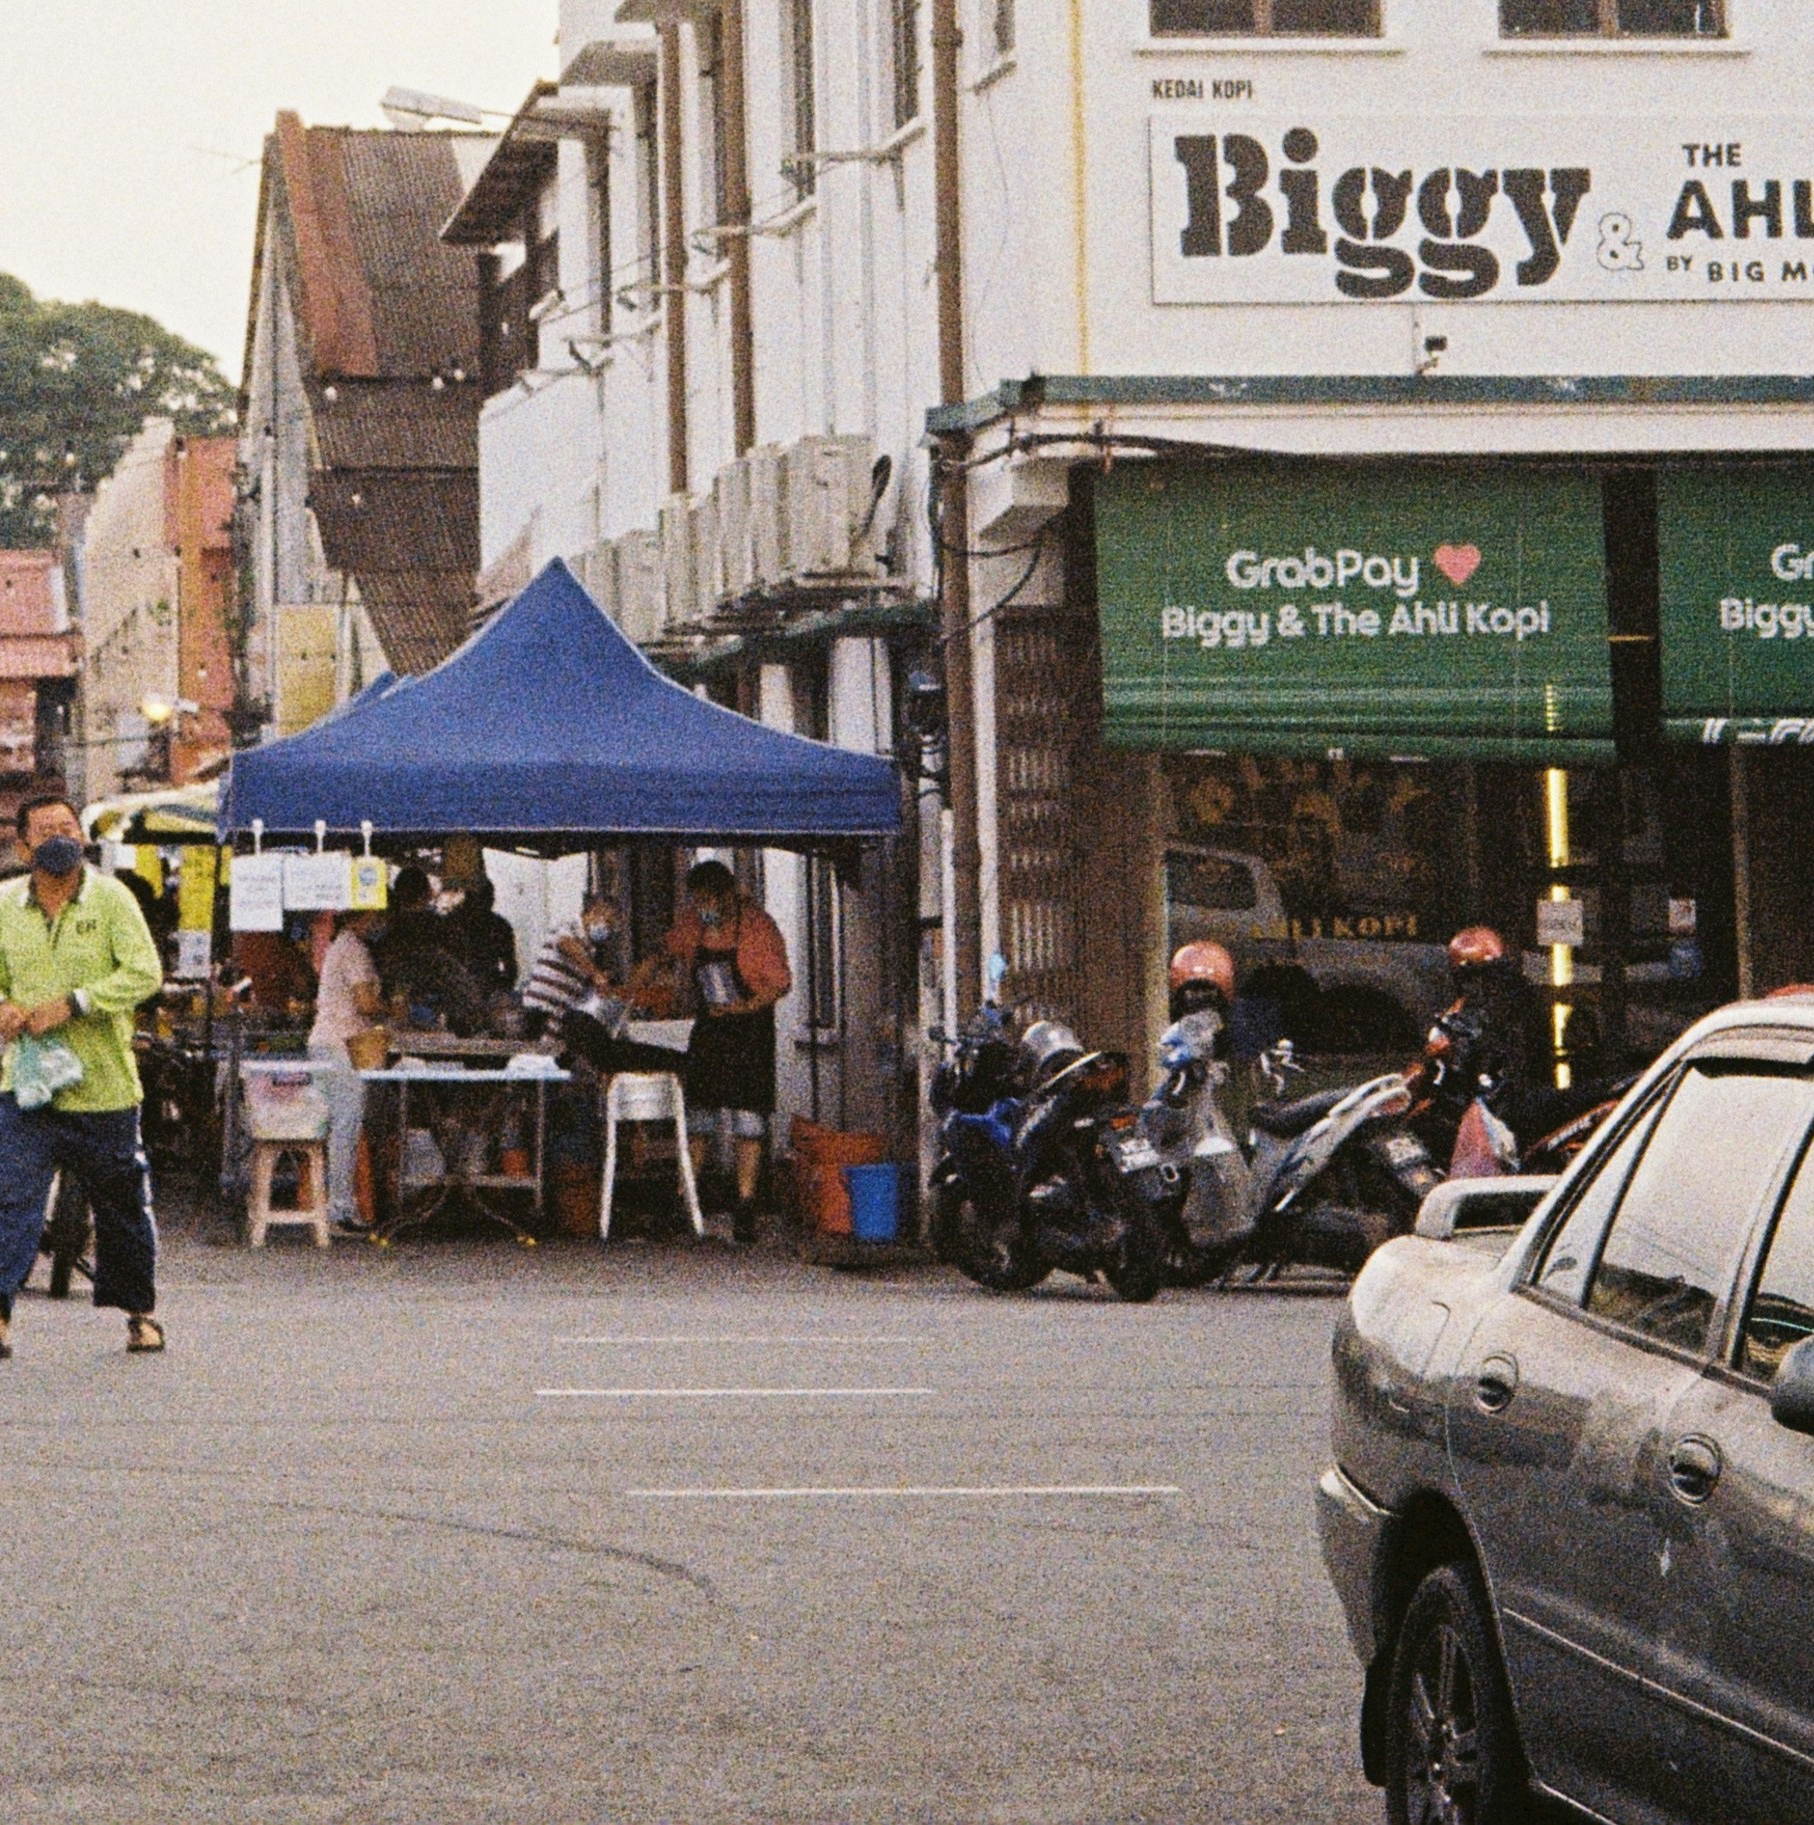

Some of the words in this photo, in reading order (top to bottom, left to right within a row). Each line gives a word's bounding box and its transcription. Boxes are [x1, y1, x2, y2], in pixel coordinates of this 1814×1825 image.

[1153, 79, 1204, 99] KEDAI
[1212, 79, 1254, 99] KOPI
[1682, 143, 1742, 168] THE
[1174, 126, 1592, 299] Biggy
[1596, 211, 1645, 272] &
[1666, 255, 1693, 272] BY
[1707, 261, 1765, 283] BIG
[1225, 548, 1420, 598] GrabPay
[1161, 605, 1270, 648] Biggy
[1278, 603, 1305, 637] &
[1311, 601, 1381, 635] The
[1388, 599, 1460, 634] Ahli
[1465, 600, 1549, 641] Kopi
